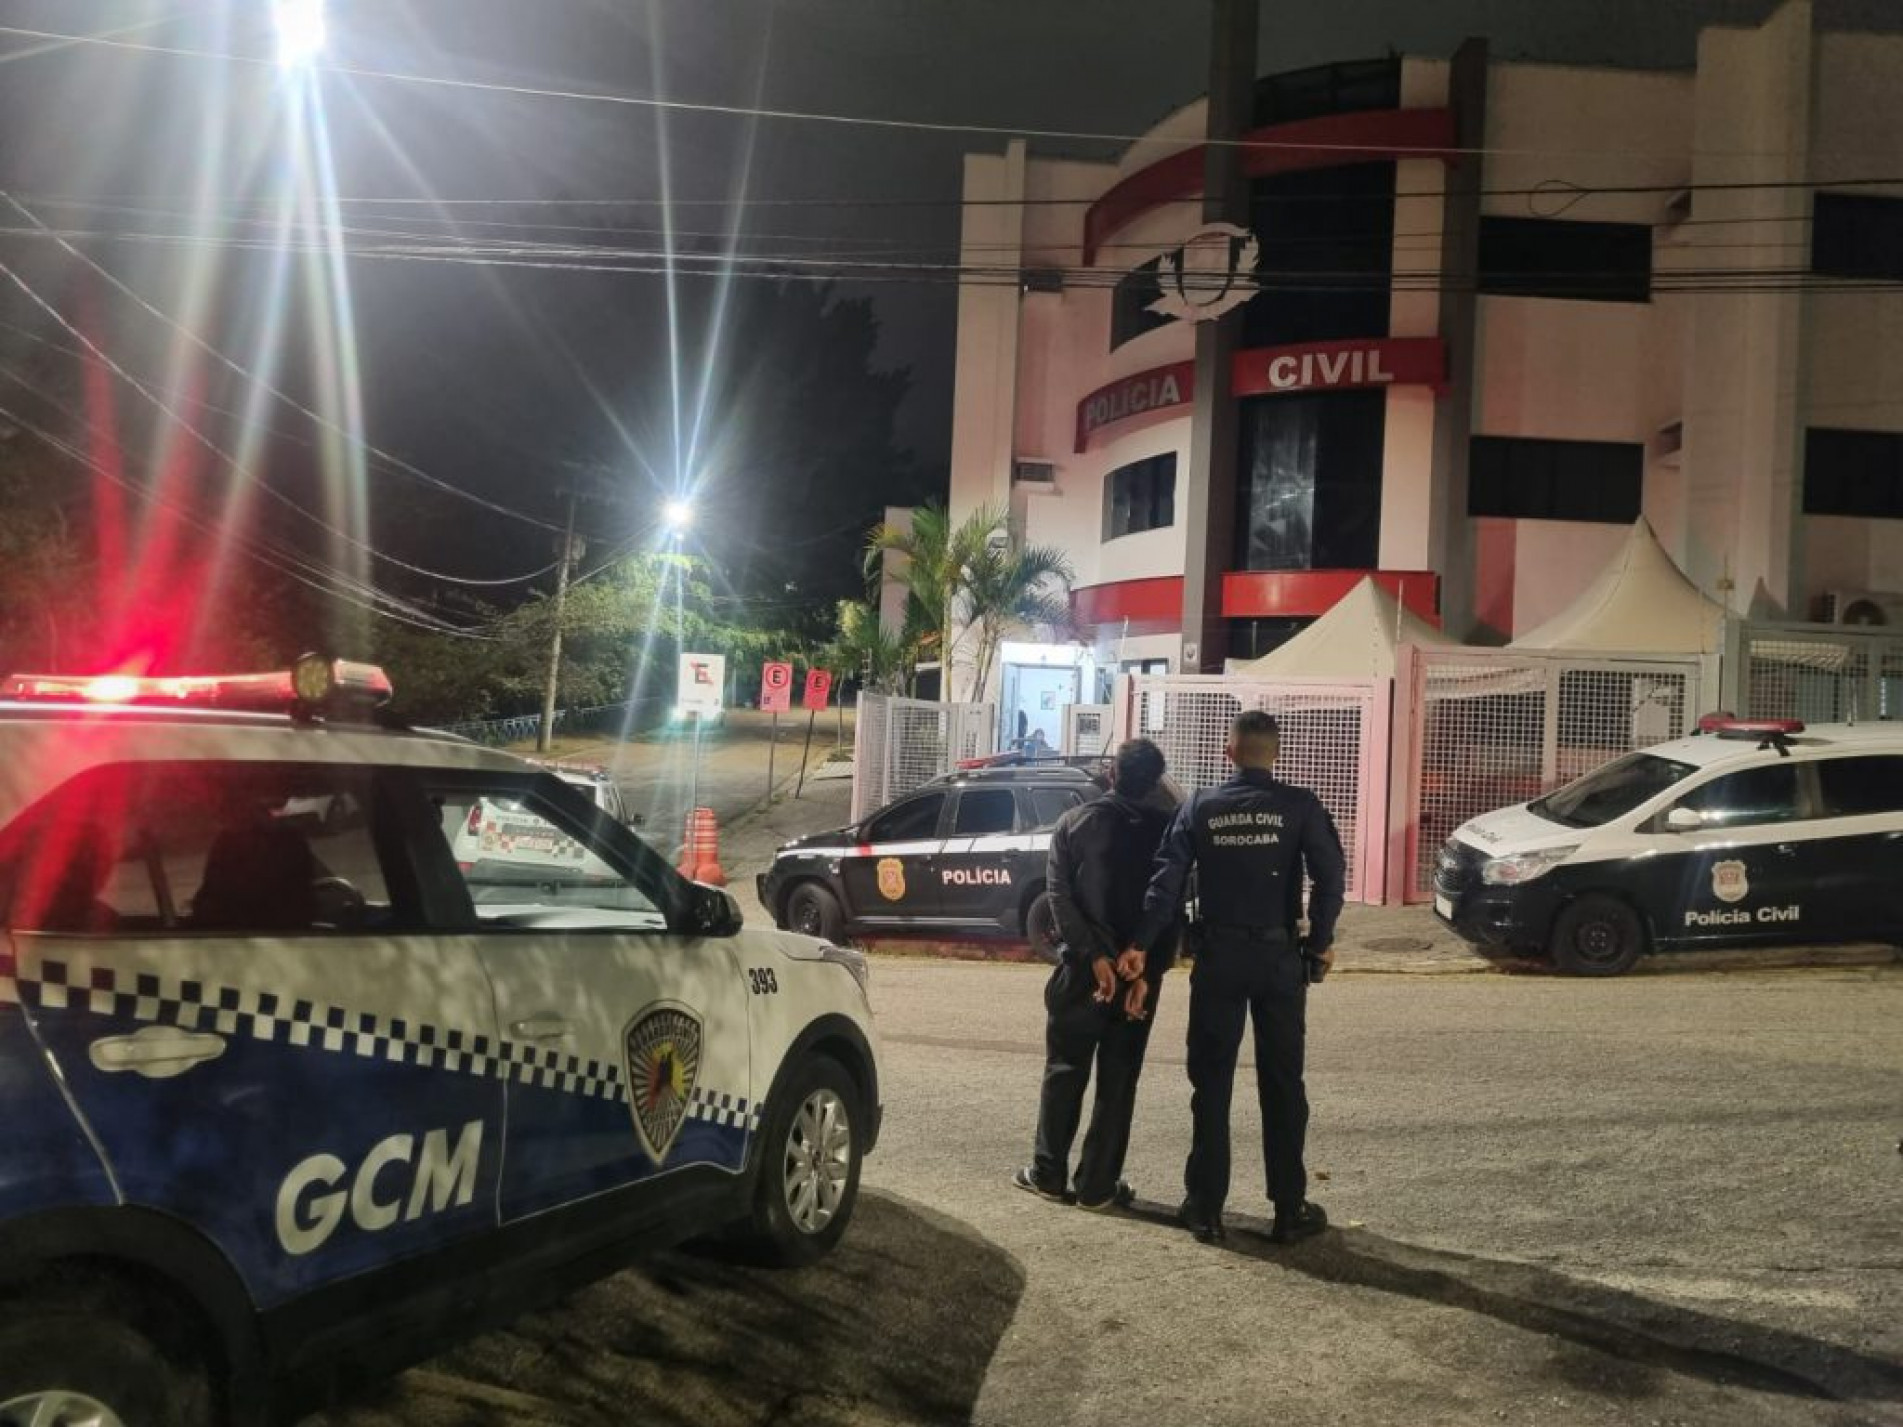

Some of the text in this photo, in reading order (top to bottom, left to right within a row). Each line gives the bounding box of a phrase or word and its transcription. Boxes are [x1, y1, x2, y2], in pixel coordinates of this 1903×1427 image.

[1268, 350, 1393, 388] CIVIL
[772, 670, 782, 684] E
[1208, 812, 1283, 829] GUARDA CIVIL
[1213, 833, 1279, 846] SOROCABA
[942, 865, 1012, 885] POLÍCIA
[1757, 905, 1800, 922] Civil
[749, 968, 777, 994] 393
[276, 1119, 484, 1256] GCM
